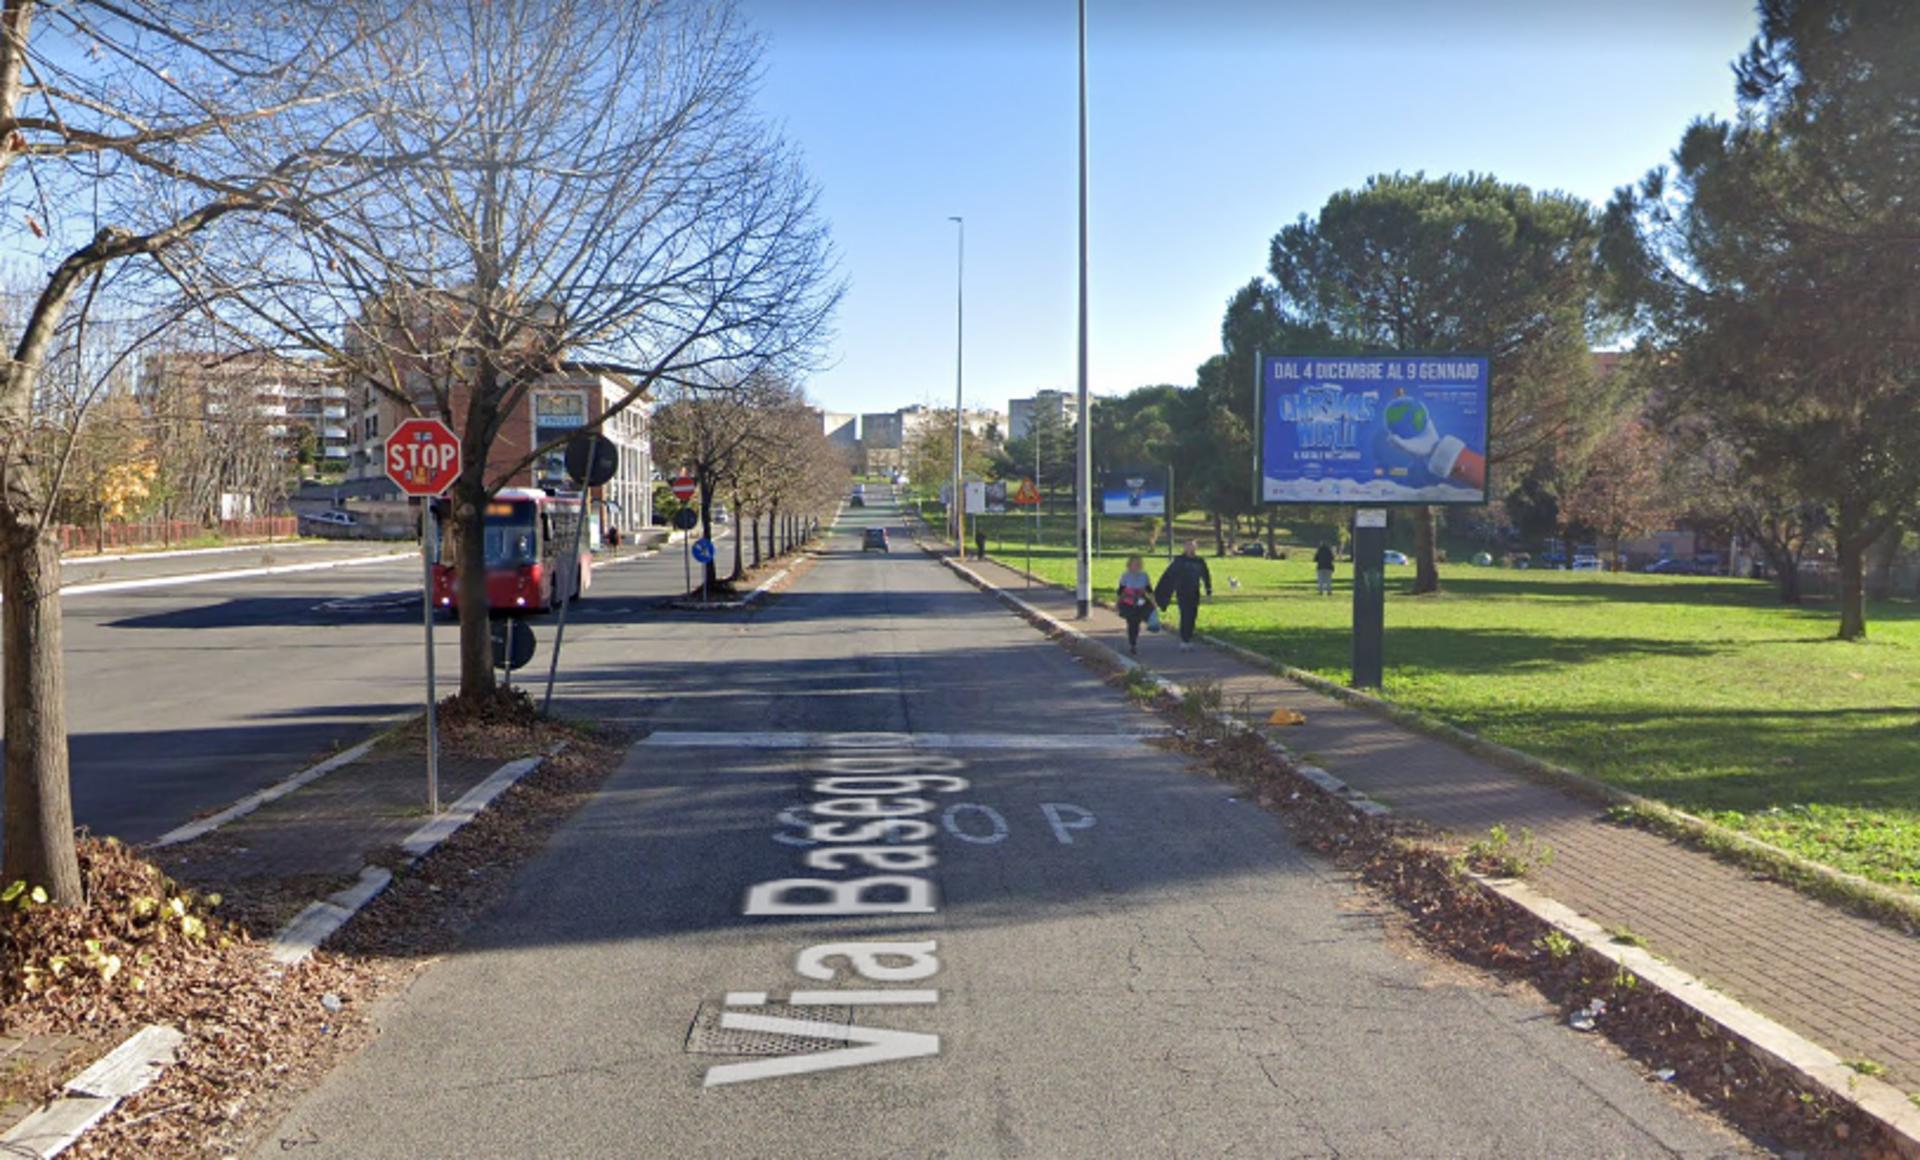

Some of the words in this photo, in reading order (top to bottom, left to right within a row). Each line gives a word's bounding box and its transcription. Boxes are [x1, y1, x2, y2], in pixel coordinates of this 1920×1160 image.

[1274, 362, 1299, 380] DAL
[1303, 362, 1312, 379] 4
[1315, 362, 1383, 379] DICEMBRE
[1386, 362, 1404, 379] AL
[1407, 362, 1416, 379] 9
[1419, 362, 1479, 379] GENNAIO
[390, 443, 456, 472] STOP
